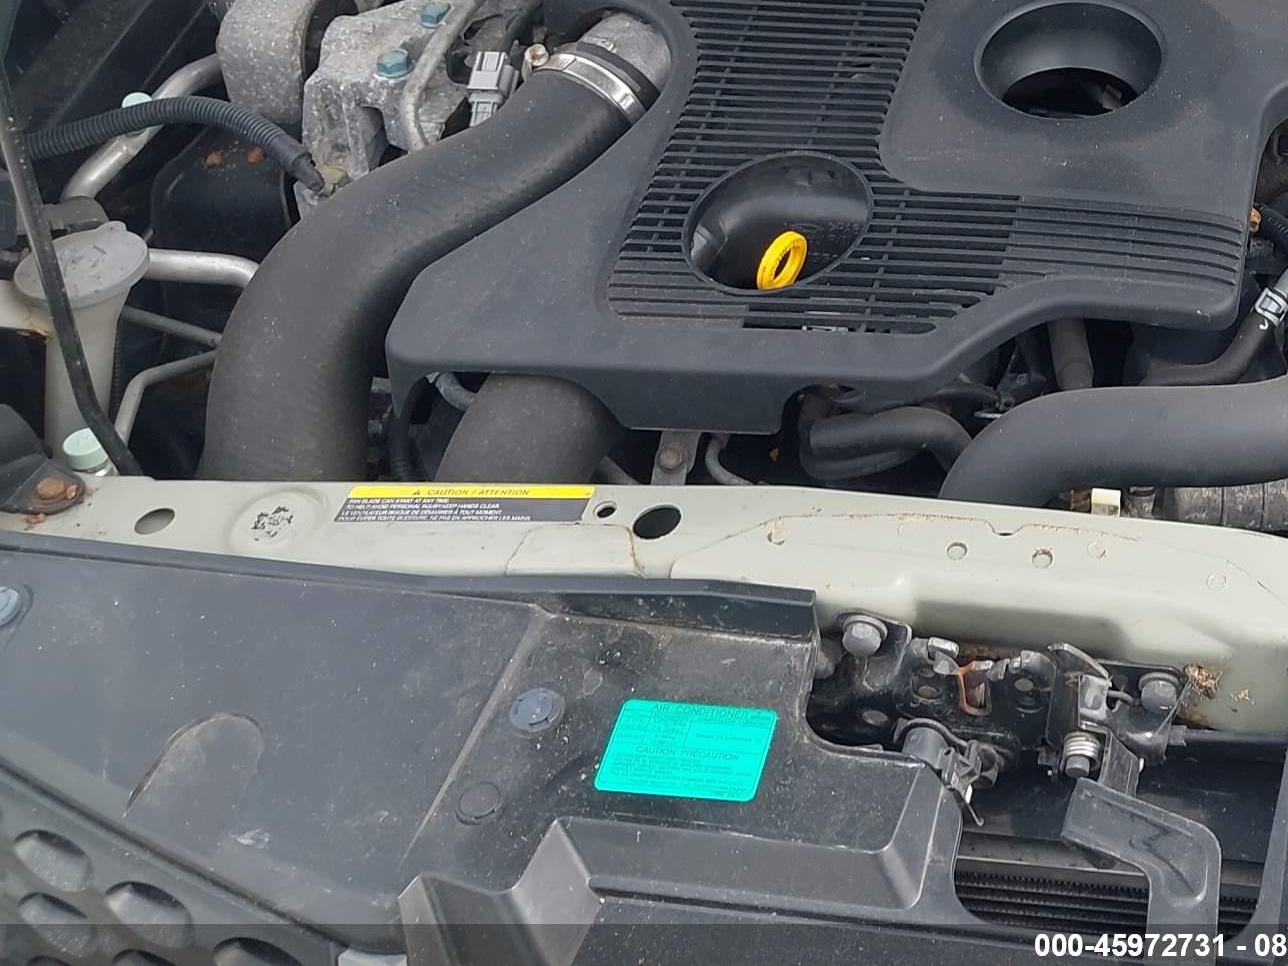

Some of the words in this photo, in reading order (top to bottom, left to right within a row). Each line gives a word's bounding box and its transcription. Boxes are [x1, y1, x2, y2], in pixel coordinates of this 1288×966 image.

[651, 704, 670, 713] AIR
[676, 705, 749, 719] CONDITIONER
[635, 745, 676, 755] CAUTION
